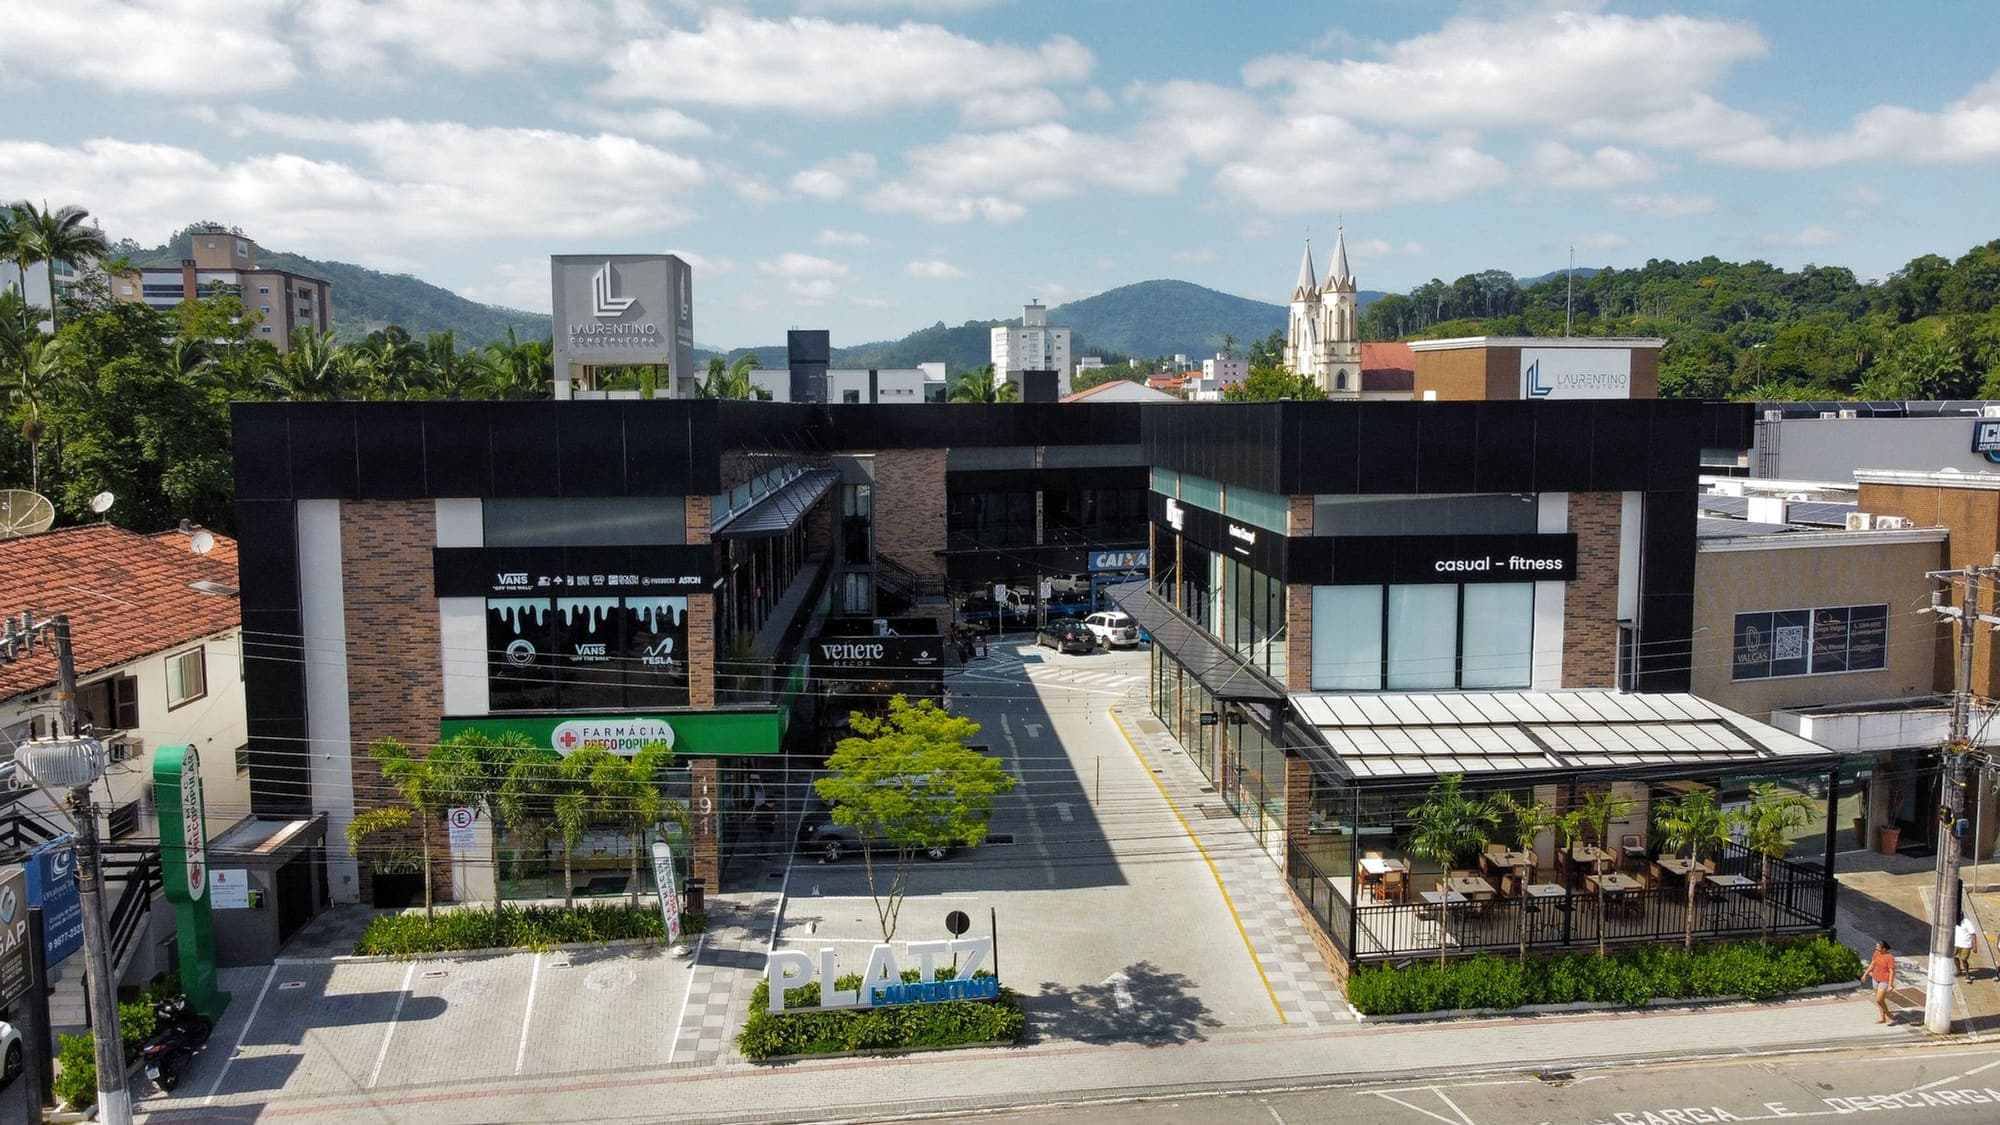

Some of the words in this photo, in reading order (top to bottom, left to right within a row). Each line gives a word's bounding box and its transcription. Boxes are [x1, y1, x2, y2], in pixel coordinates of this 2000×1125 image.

[569, 323, 656, 335] LAURENTINO
[1557, 373, 1627, 385] LAURENTINO
[1979, 423, 2000, 443] IC
[1096, 552, 1147, 568] CAIXA
[1434, 556, 1490, 571] casual
[1508, 555, 1563, 570] fitness
[497, 573, 528, 585] VANS
[679, 576, 701, 585] ASTON
[575, 643, 606, 656] VANS
[820, 643, 884, 660] venere
[642, 656, 673, 665] TESLA
[583, 724, 666, 737] FARMÁCIA
[699, 776, 711, 835] 191
[457, 813, 466, 824] E
[768, 936, 991, 1012] PLATZ
[871, 976, 999, 1006] LAURENTINO
[1613, 1106, 1740, 1125] CARGA
[1763, 1101, 1798, 1117] E
[1821, 1087, 2000, 1114] DESCARGA
